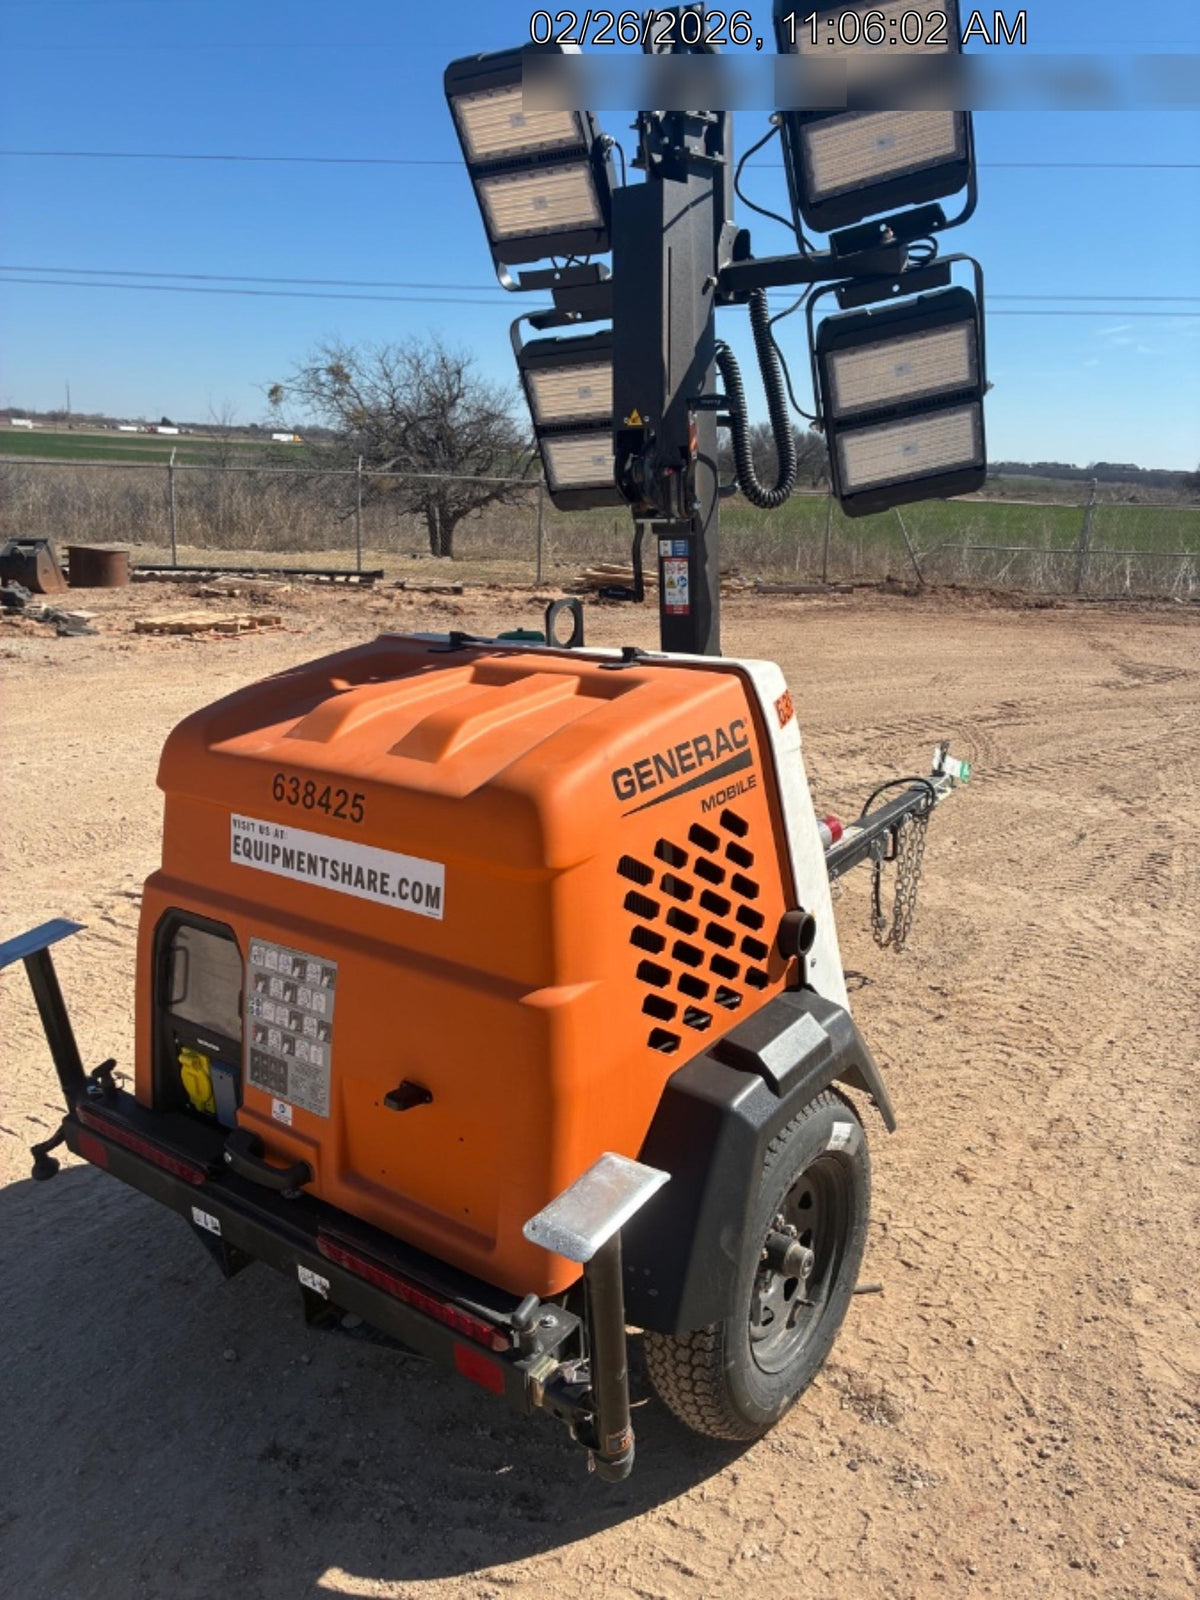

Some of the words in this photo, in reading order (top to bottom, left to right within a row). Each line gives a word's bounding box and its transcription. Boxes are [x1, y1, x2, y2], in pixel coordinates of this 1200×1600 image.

[611, 719, 748, 801] GENERAC
[272, 773, 365, 823] 638425
[701, 774, 757, 814] MOBILE
[232, 818, 255, 833] VISIT
[259, 824, 271, 836] US
[233, 834, 442, 910] EQUIPMENTSHARE.COM
